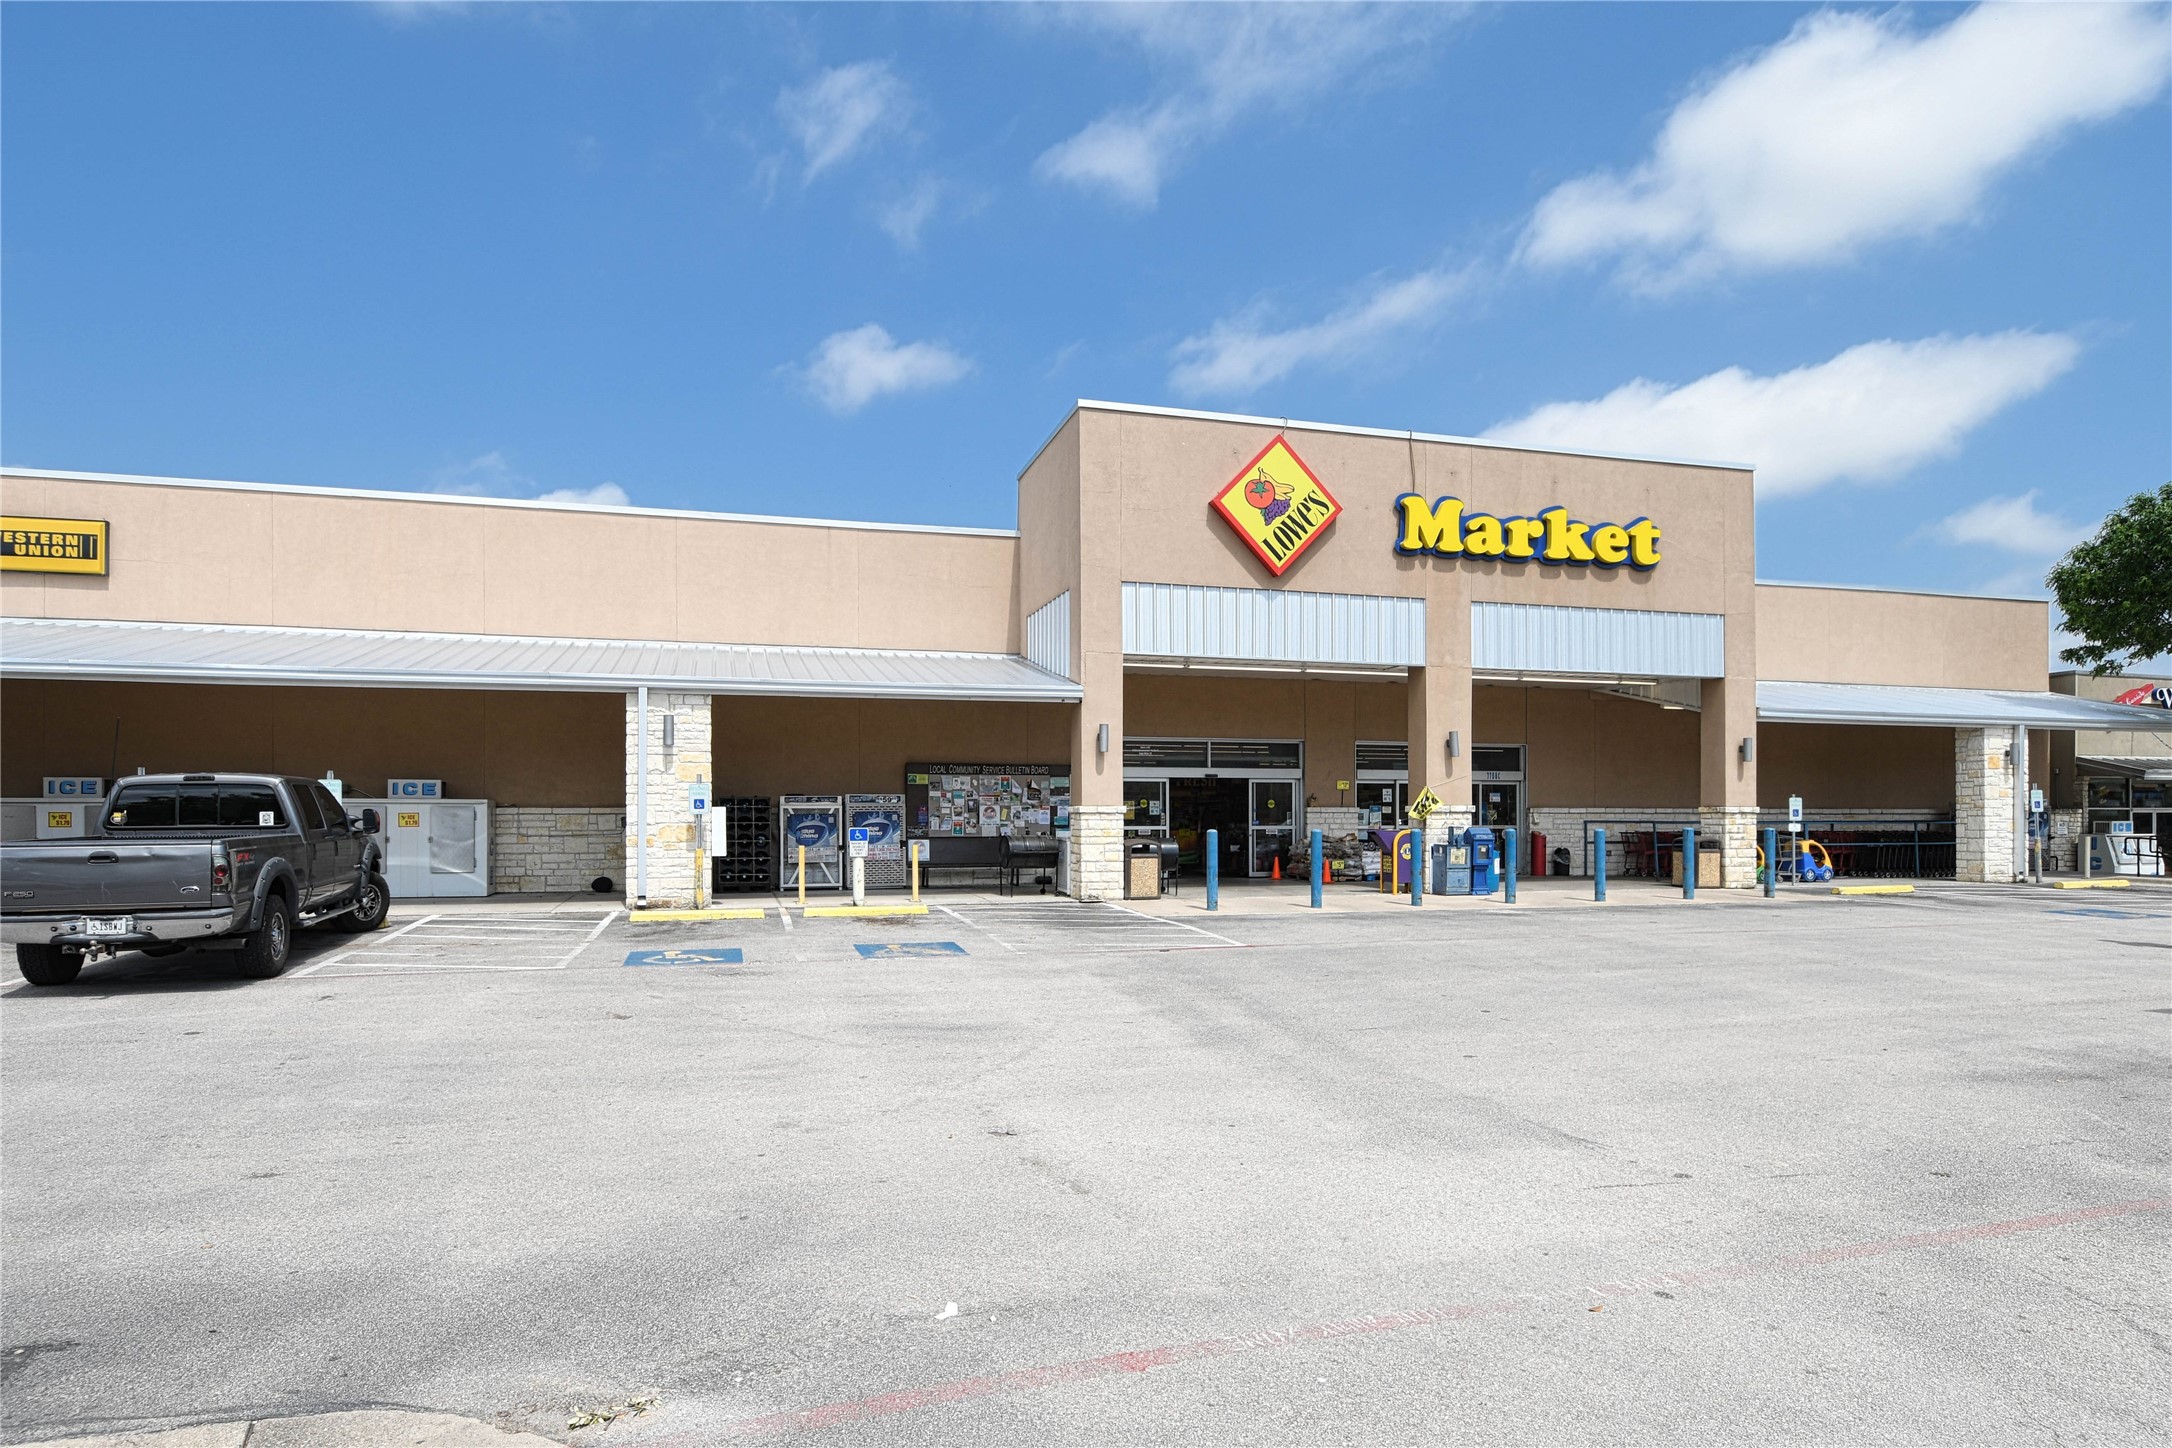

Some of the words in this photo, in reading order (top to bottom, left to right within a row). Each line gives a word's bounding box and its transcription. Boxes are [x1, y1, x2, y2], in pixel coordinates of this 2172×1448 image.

[1397, 494, 1661, 568] Market
[0, 531, 79, 546] ESTERN
[14, 544, 79, 557] UNION
[929, 764, 947, 774] LOCAL
[948, 764, 980, 774] COMMUNITY
[982, 765, 1005, 774] SERVICE
[1005, 766, 1030, 775] BULLETIN
[1031, 766, 1049, 775] BOARD
[48, 780, 97, 794] ICE
[391, 782, 437, 796] ICE
